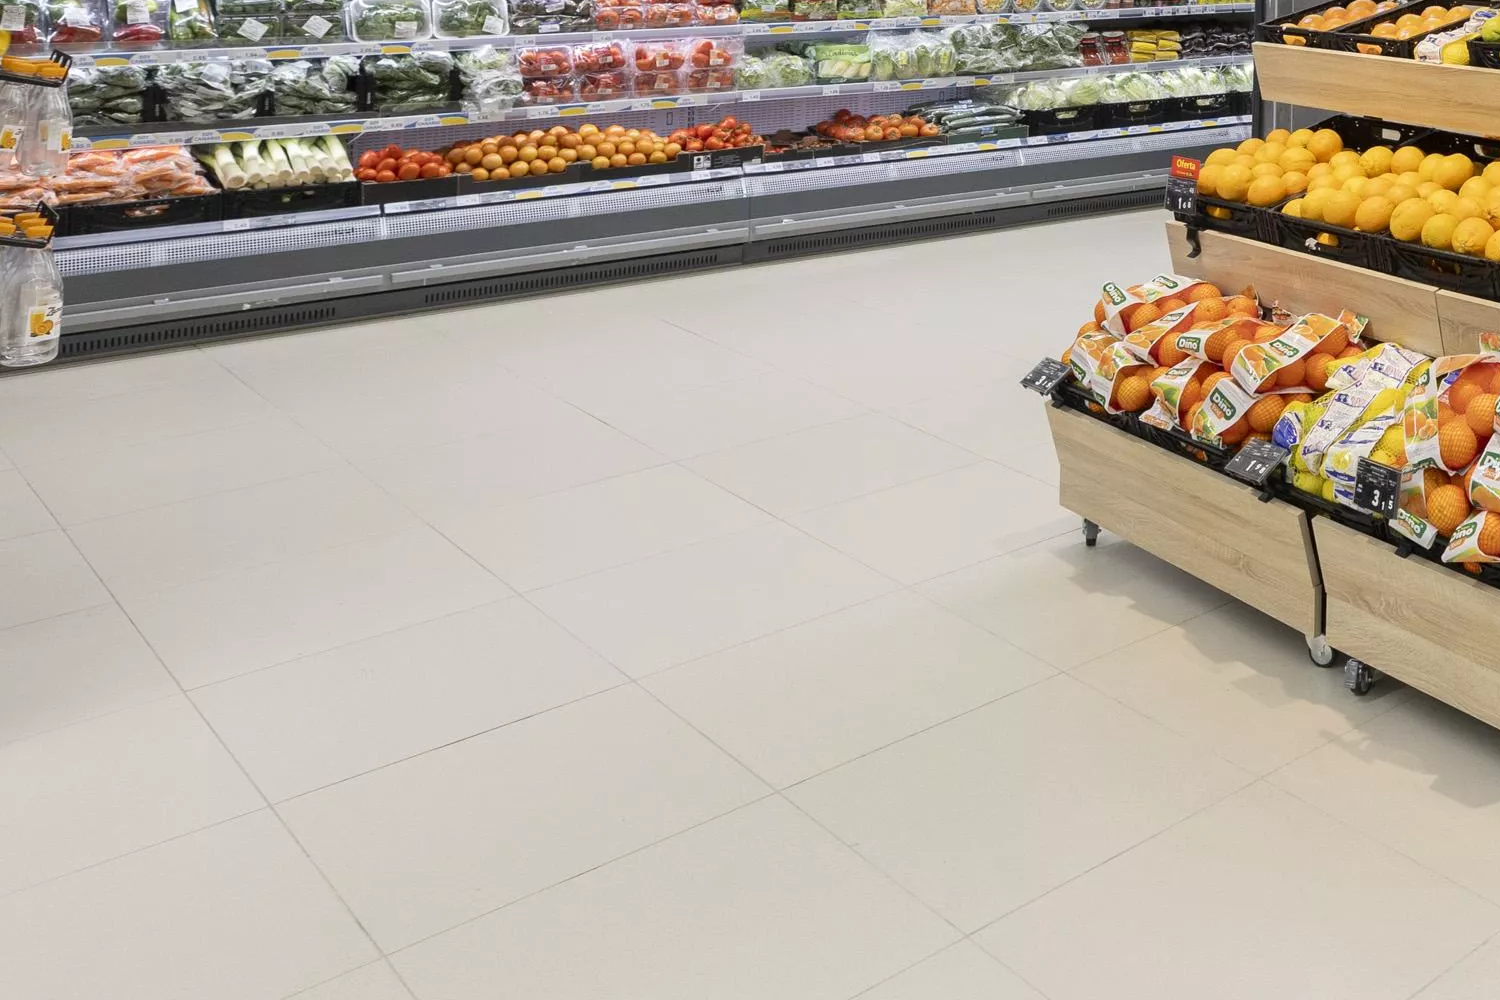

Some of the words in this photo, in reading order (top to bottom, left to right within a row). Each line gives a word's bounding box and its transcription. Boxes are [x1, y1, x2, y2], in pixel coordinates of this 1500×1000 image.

[1176, 159, 1196, 170] Oferta
[1105, 285, 1121, 303] Dino
[1179, 338, 1198, 350] Dino
[1212, 391, 1232, 417] Dino
[1399, 511, 1421, 534] Dino
